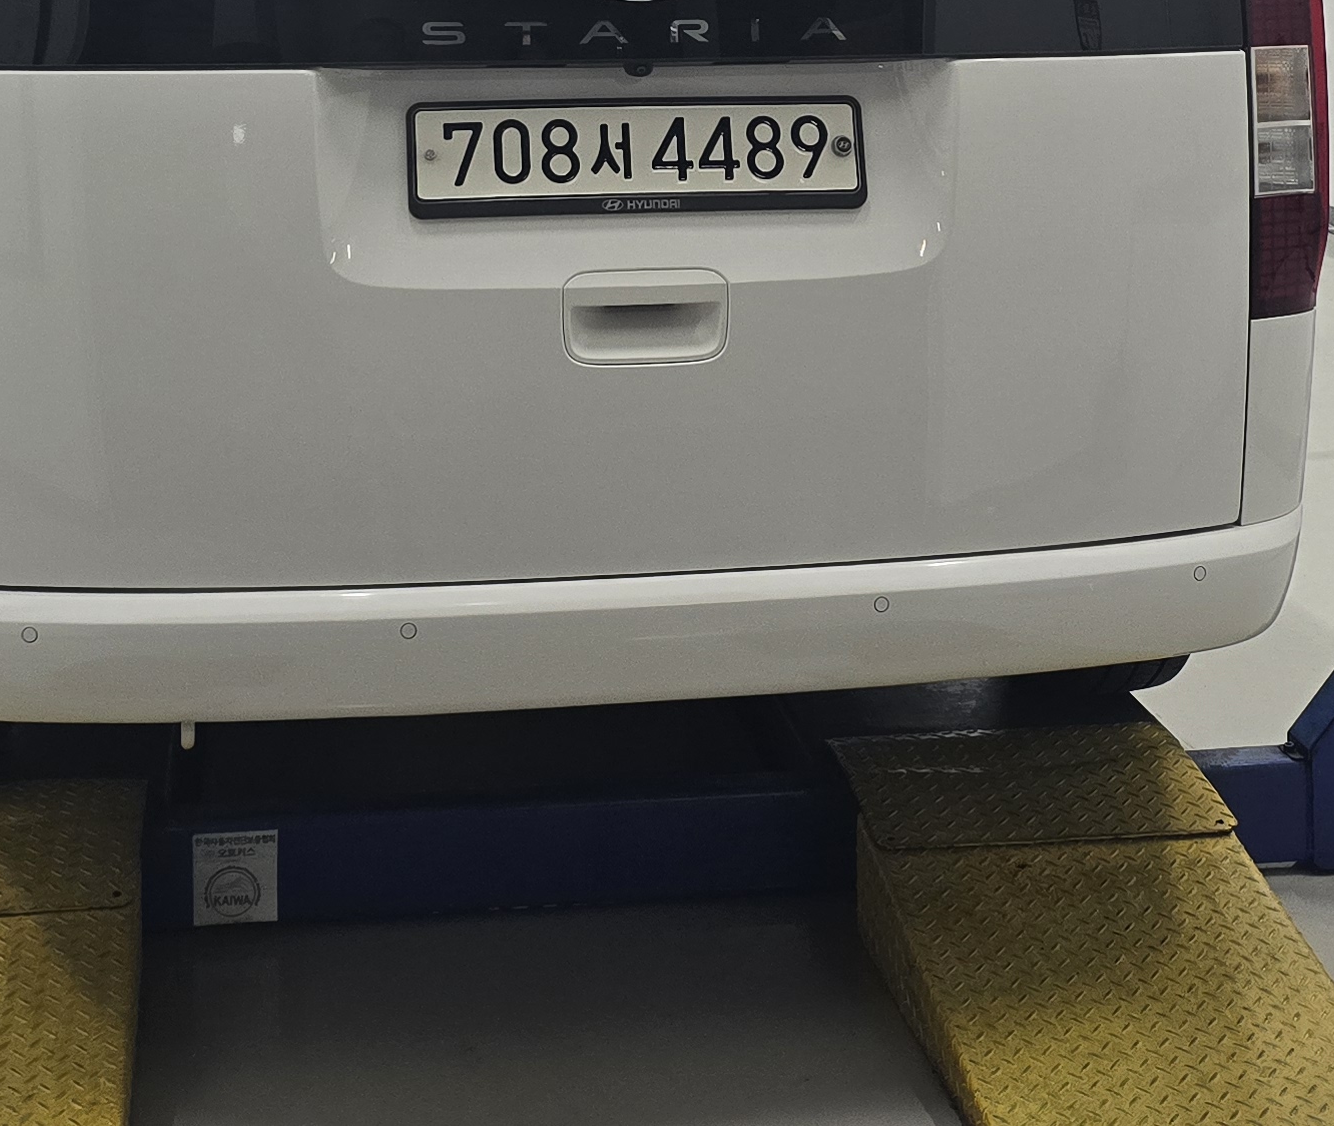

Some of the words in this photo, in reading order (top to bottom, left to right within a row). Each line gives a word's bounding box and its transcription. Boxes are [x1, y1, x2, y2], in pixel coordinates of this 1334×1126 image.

[421, 17, 847, 46] STARIA
[442, 117, 632, 187] 708서
[652, 114, 828, 182] 4489
[627, 198, 681, 210] HYUNDAI
[213, 894, 253, 907] KAIWA
